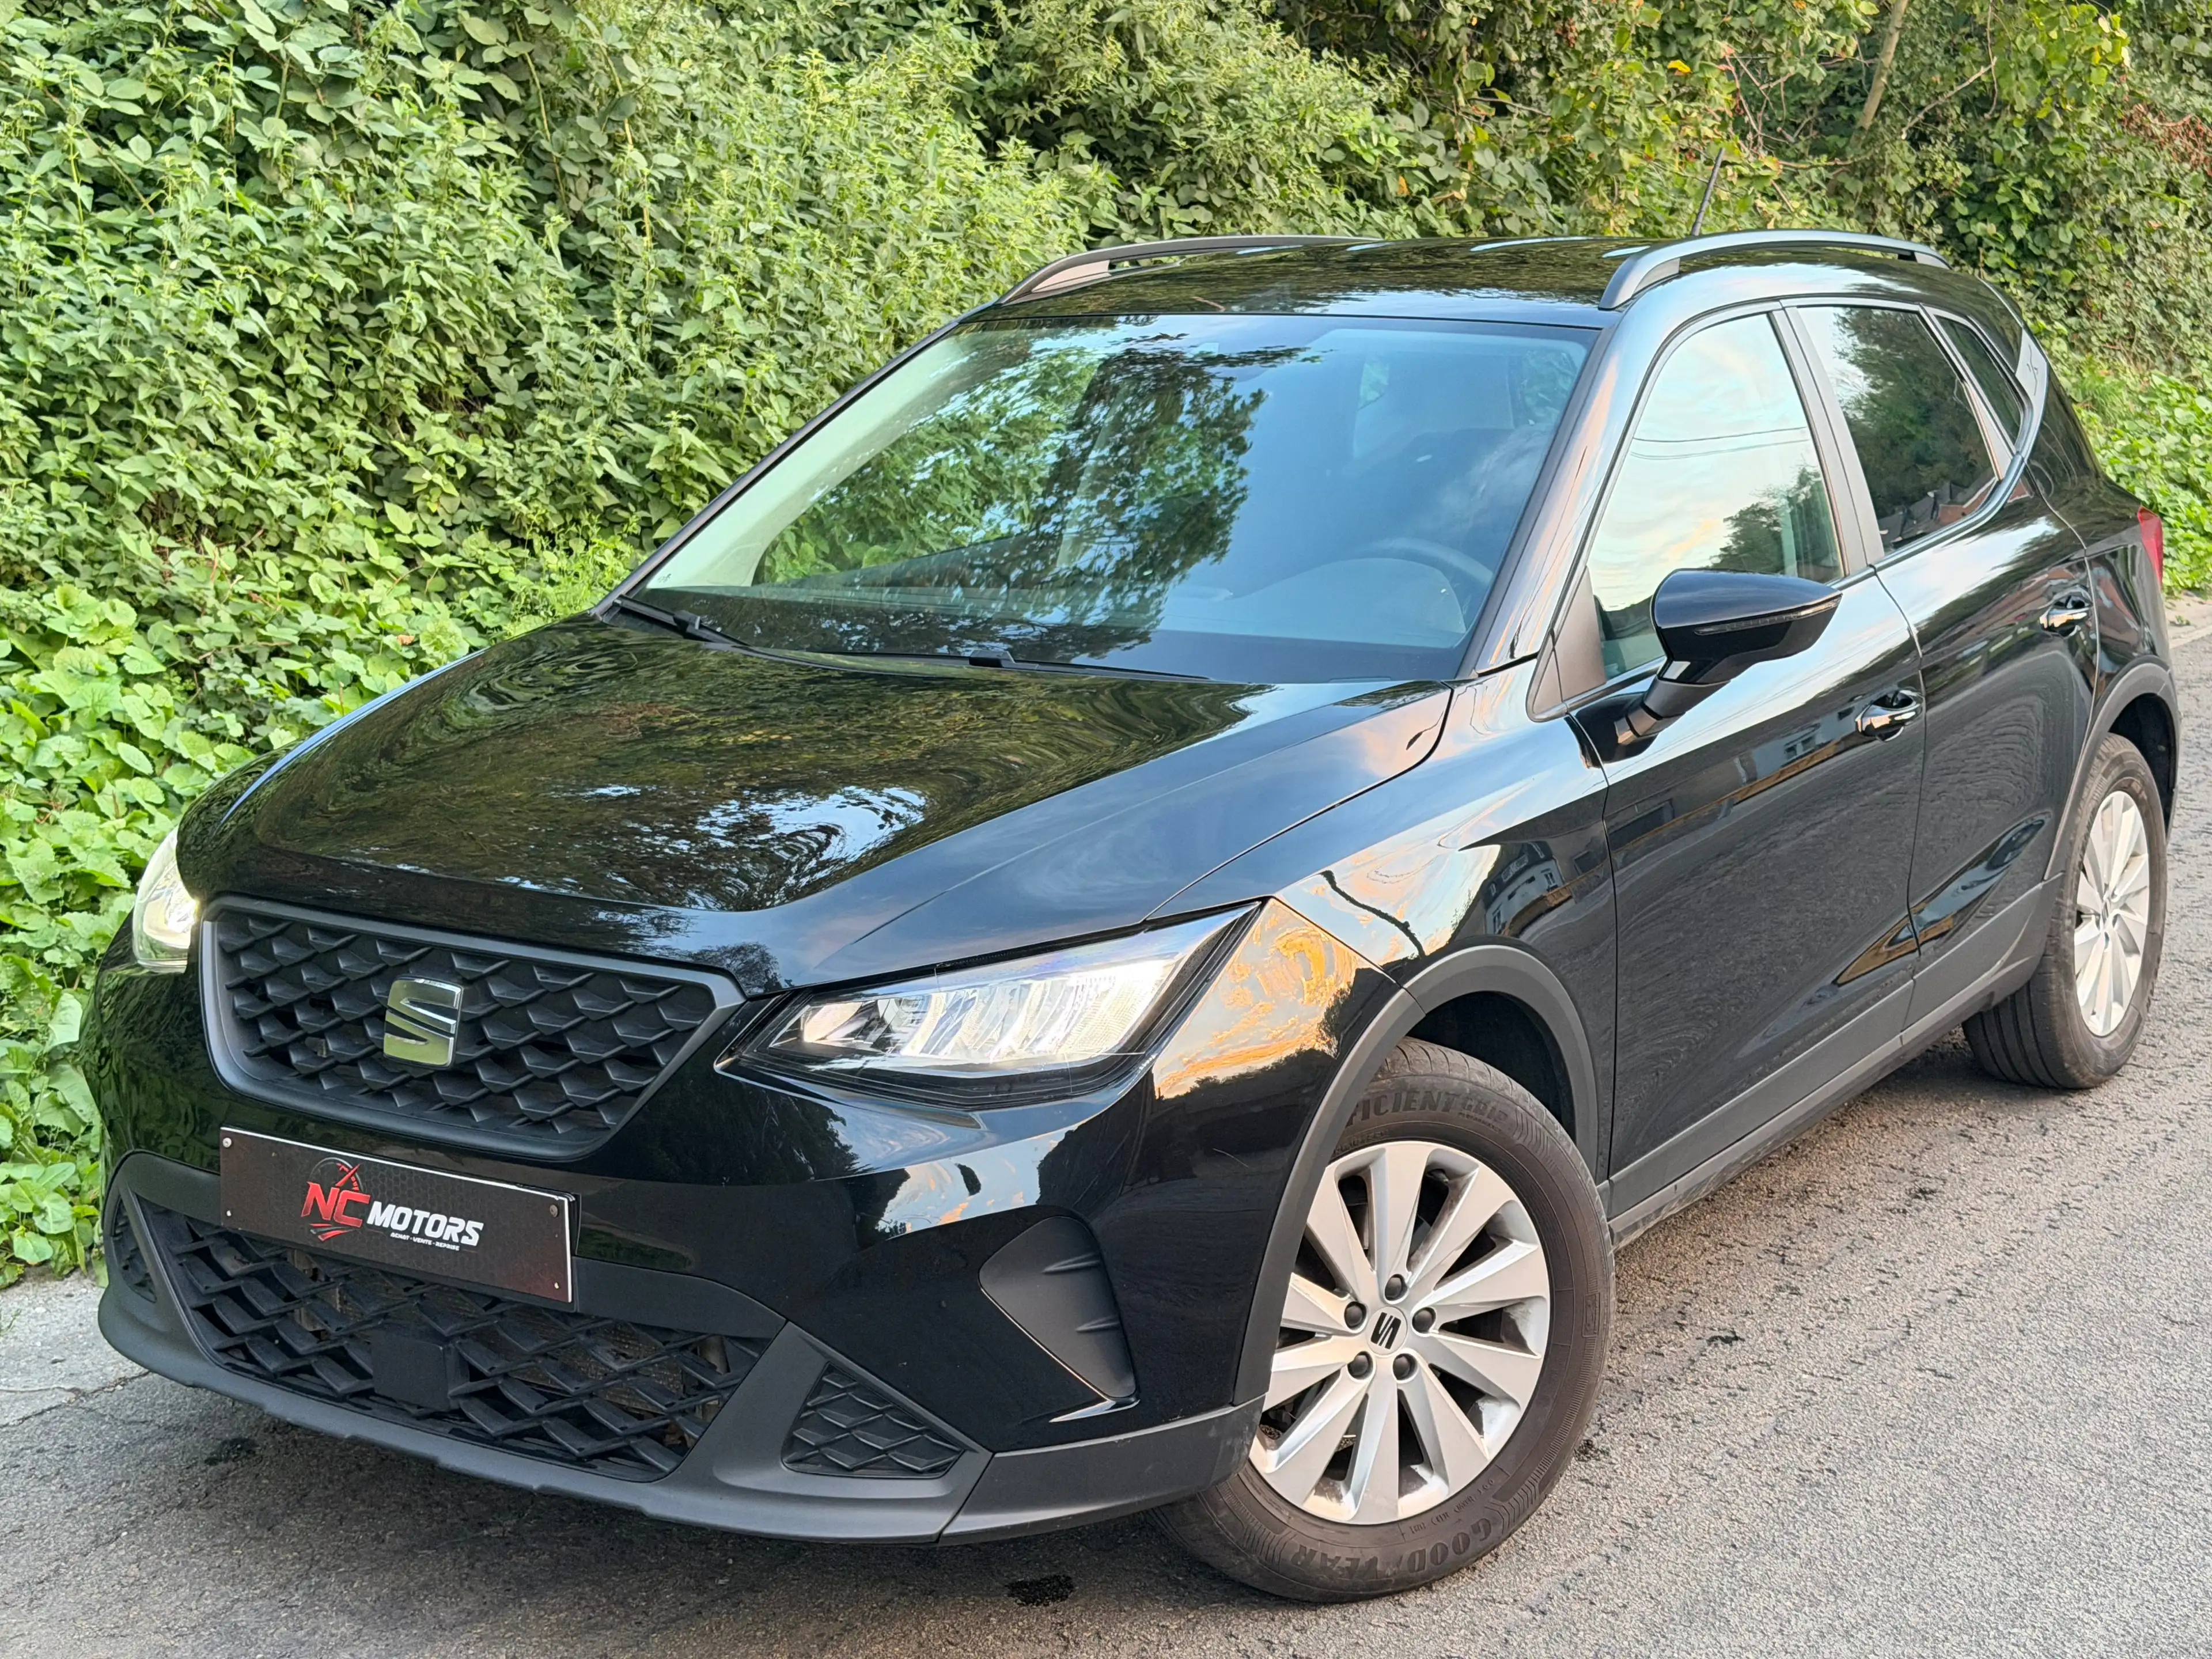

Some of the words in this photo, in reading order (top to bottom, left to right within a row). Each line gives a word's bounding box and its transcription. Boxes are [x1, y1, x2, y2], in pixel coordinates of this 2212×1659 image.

[300, 1181, 371, 1228] NC
[366, 1200, 484, 1247] MOTORS
[390, 1232, 410, 1240] ACHAT
[412, 1236, 432, 1245] VENTE
[435, 1241, 460, 1251] REPRISE
